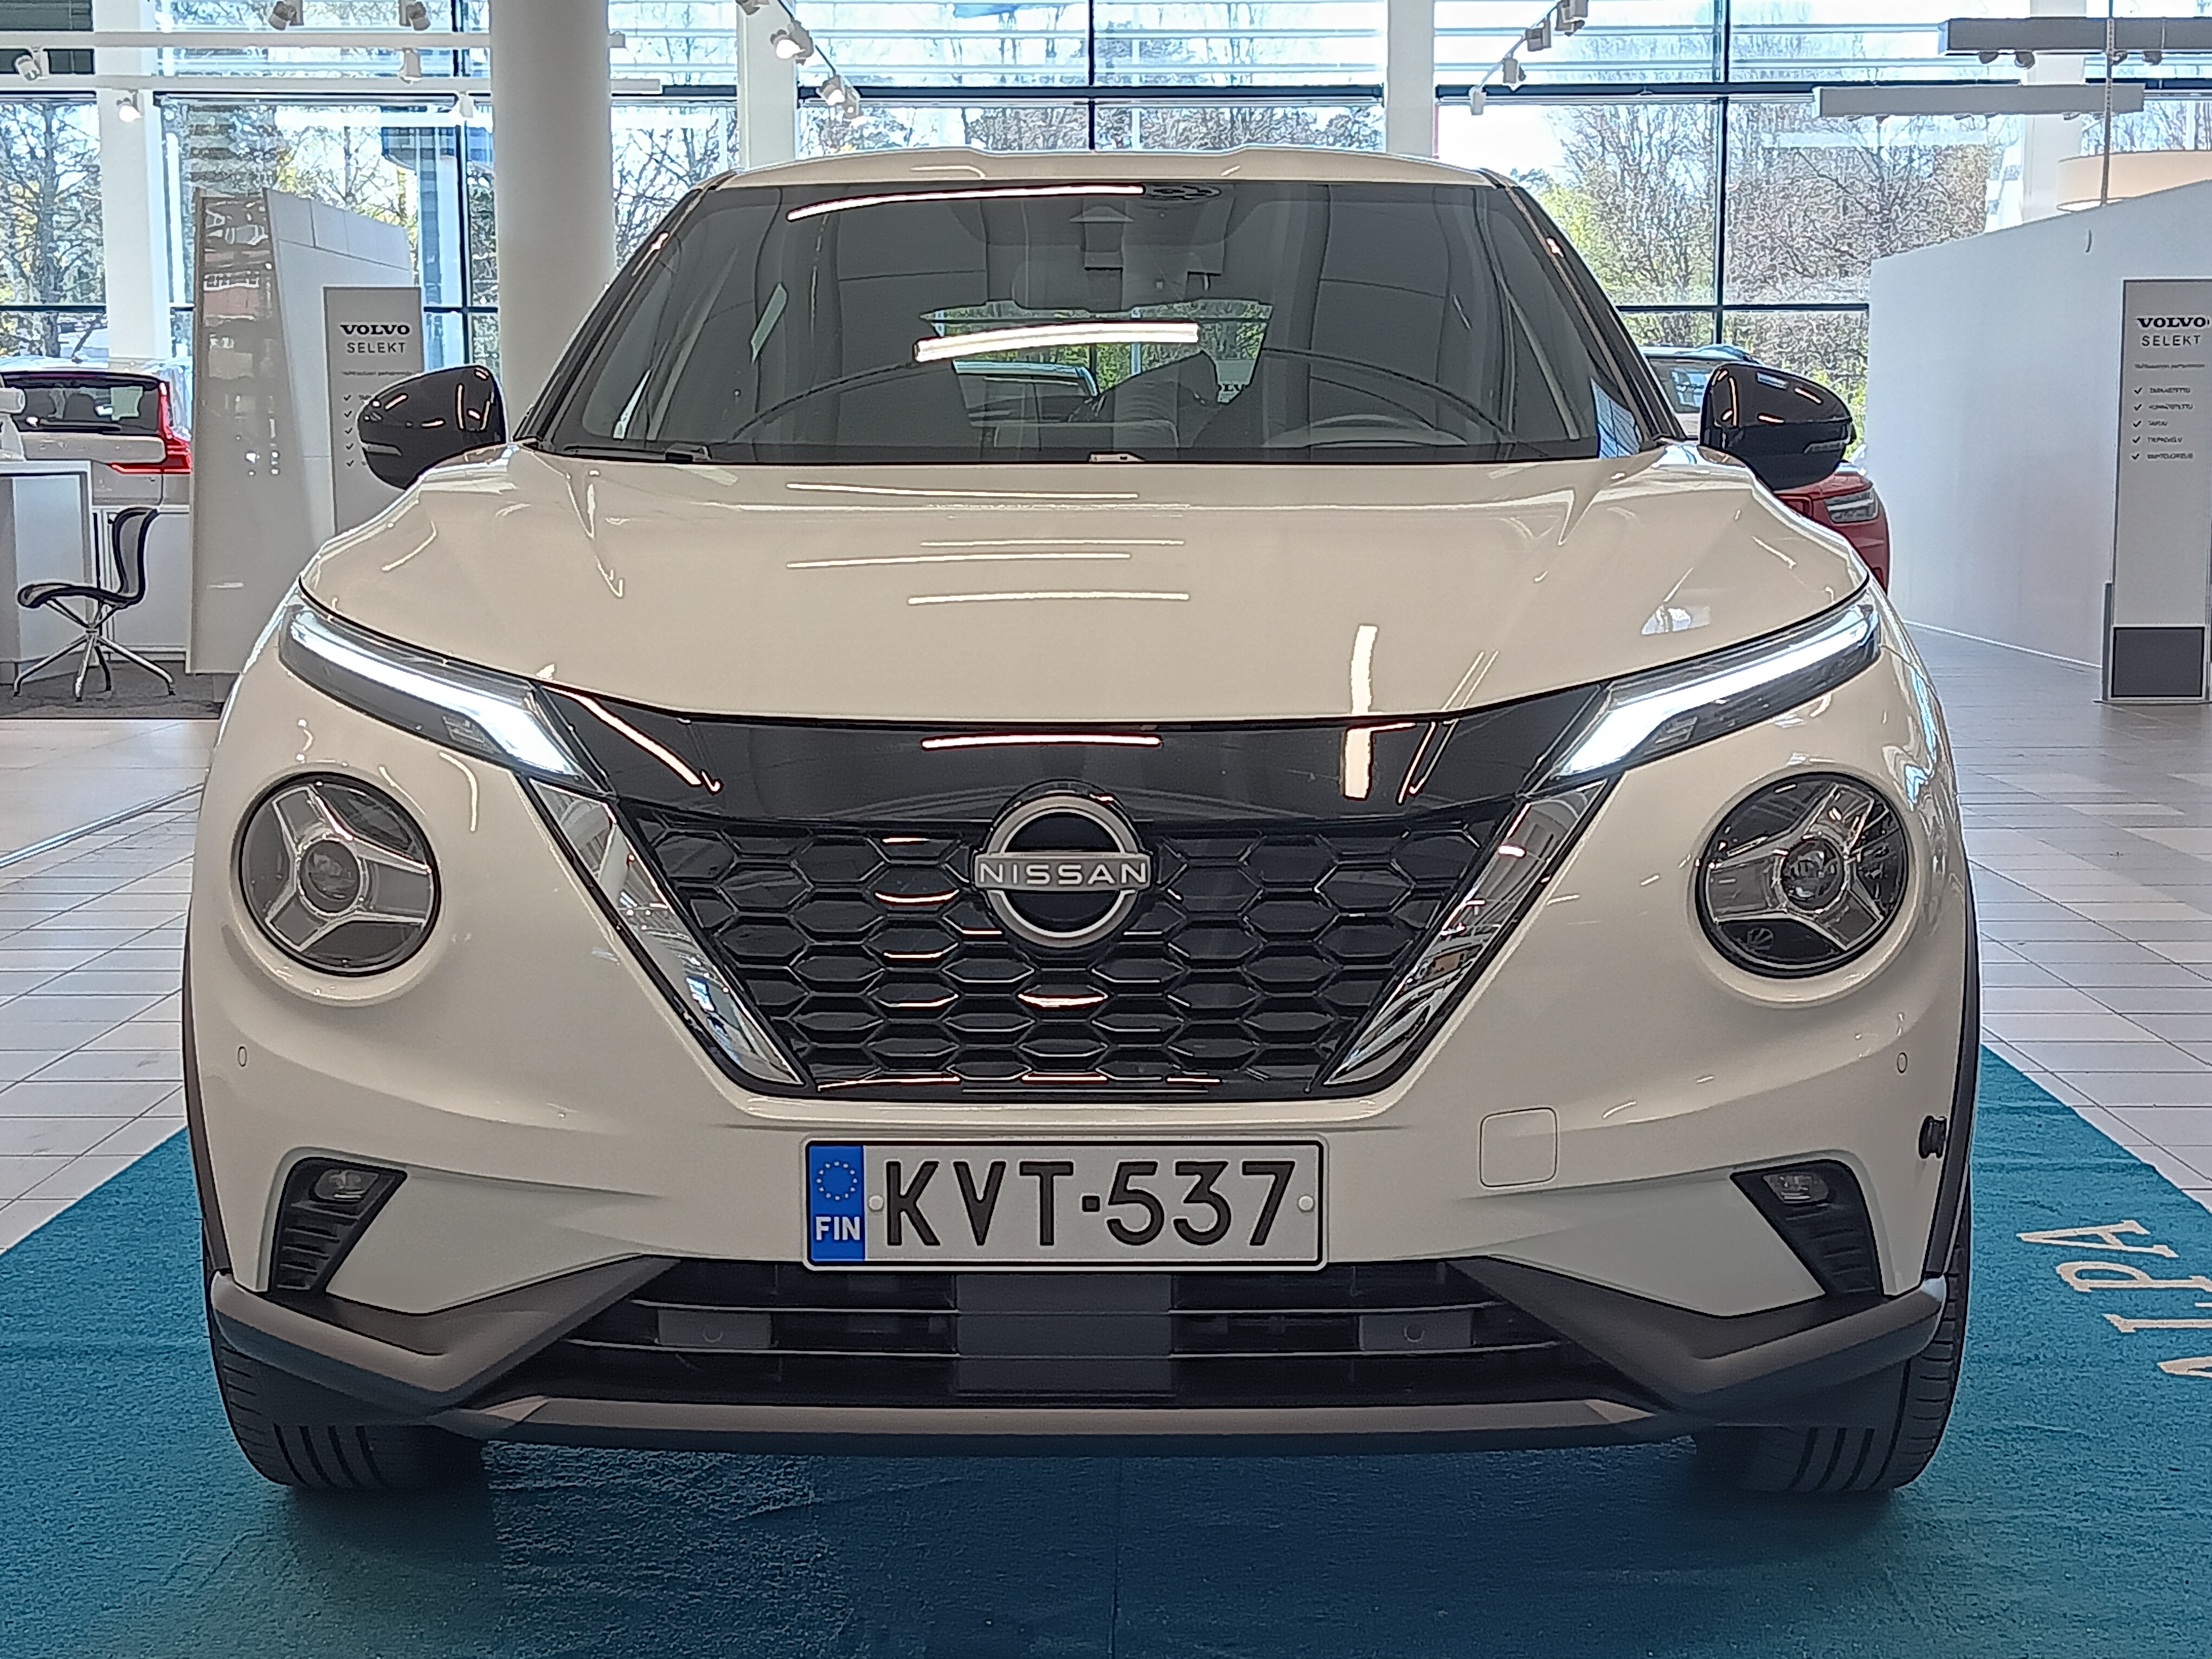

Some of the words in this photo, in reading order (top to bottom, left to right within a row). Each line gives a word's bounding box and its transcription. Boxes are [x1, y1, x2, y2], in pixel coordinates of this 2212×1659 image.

[2137, 317, 2206, 328] VOLVO
[340, 325, 410, 335] VOLVO
[2142, 335, 2201, 346] SELEKT
[347, 342, 406, 353] SELEKT
[980, 863, 1148, 885] NISSAN
[815, 1216, 861, 1241] FIN
